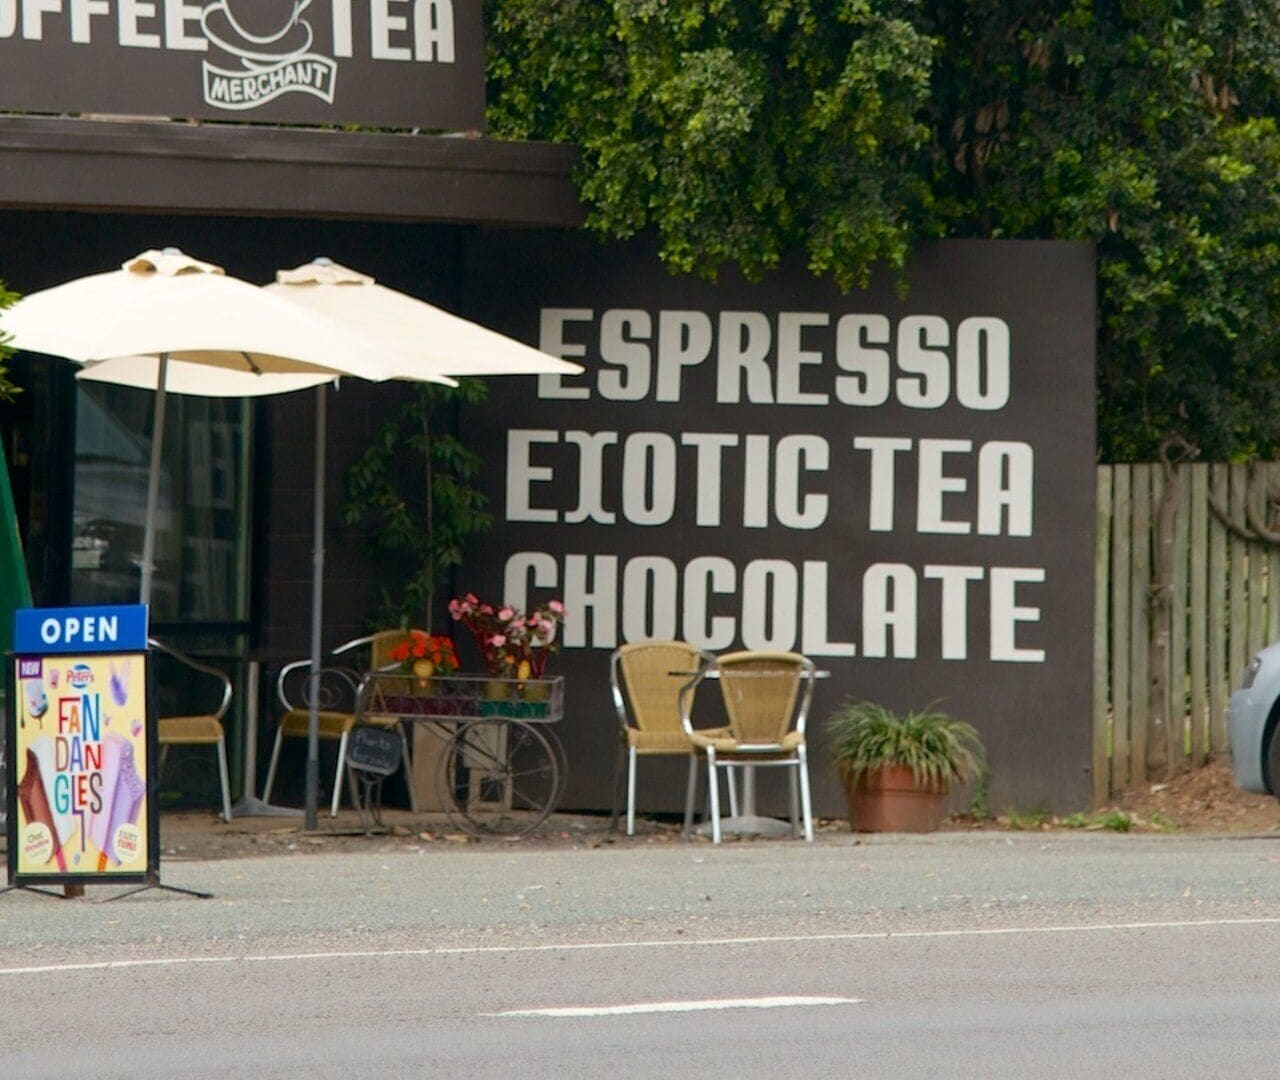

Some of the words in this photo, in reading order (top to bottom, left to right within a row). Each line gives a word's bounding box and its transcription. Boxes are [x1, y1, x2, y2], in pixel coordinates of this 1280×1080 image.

[211, 63, 329, 102] MERCHANT
[538, 308, 1011, 410] ESPRESSO
[506, 429, 829, 530] EXOTIC
[853, 436, 1034, 537] TEA
[503, 552, 1045, 662] CHOCOLATE
[40, 615, 119, 645] OPEN
[58, 693, 100, 741] FAN
[55, 736, 102, 772] DAN
[54, 773, 103, 815] GLES
